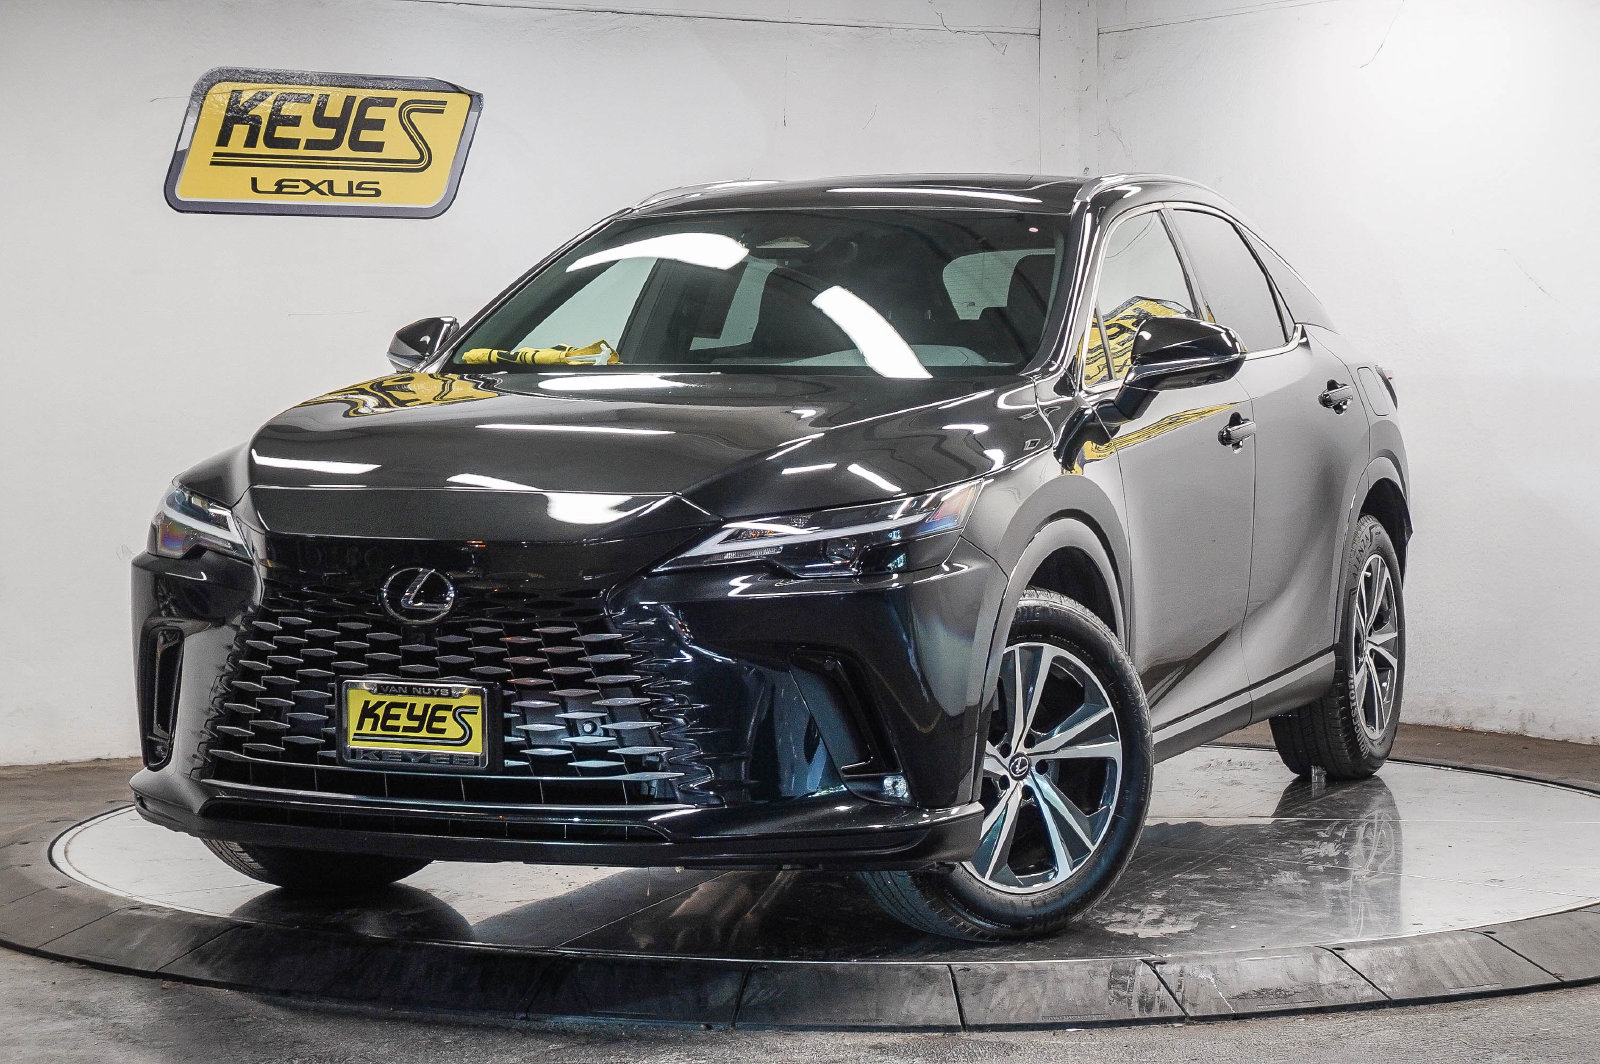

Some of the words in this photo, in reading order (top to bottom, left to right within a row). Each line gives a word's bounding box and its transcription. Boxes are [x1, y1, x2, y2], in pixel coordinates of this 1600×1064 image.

[211, 89, 448, 172] KEYES
[250, 176, 382, 198] LEXUS
[380, 685, 408, 695] VAN
[412, 686, 449, 696] NUYS
[352, 699, 479, 746] KEYES
[355, 749, 475, 765] KEYES
